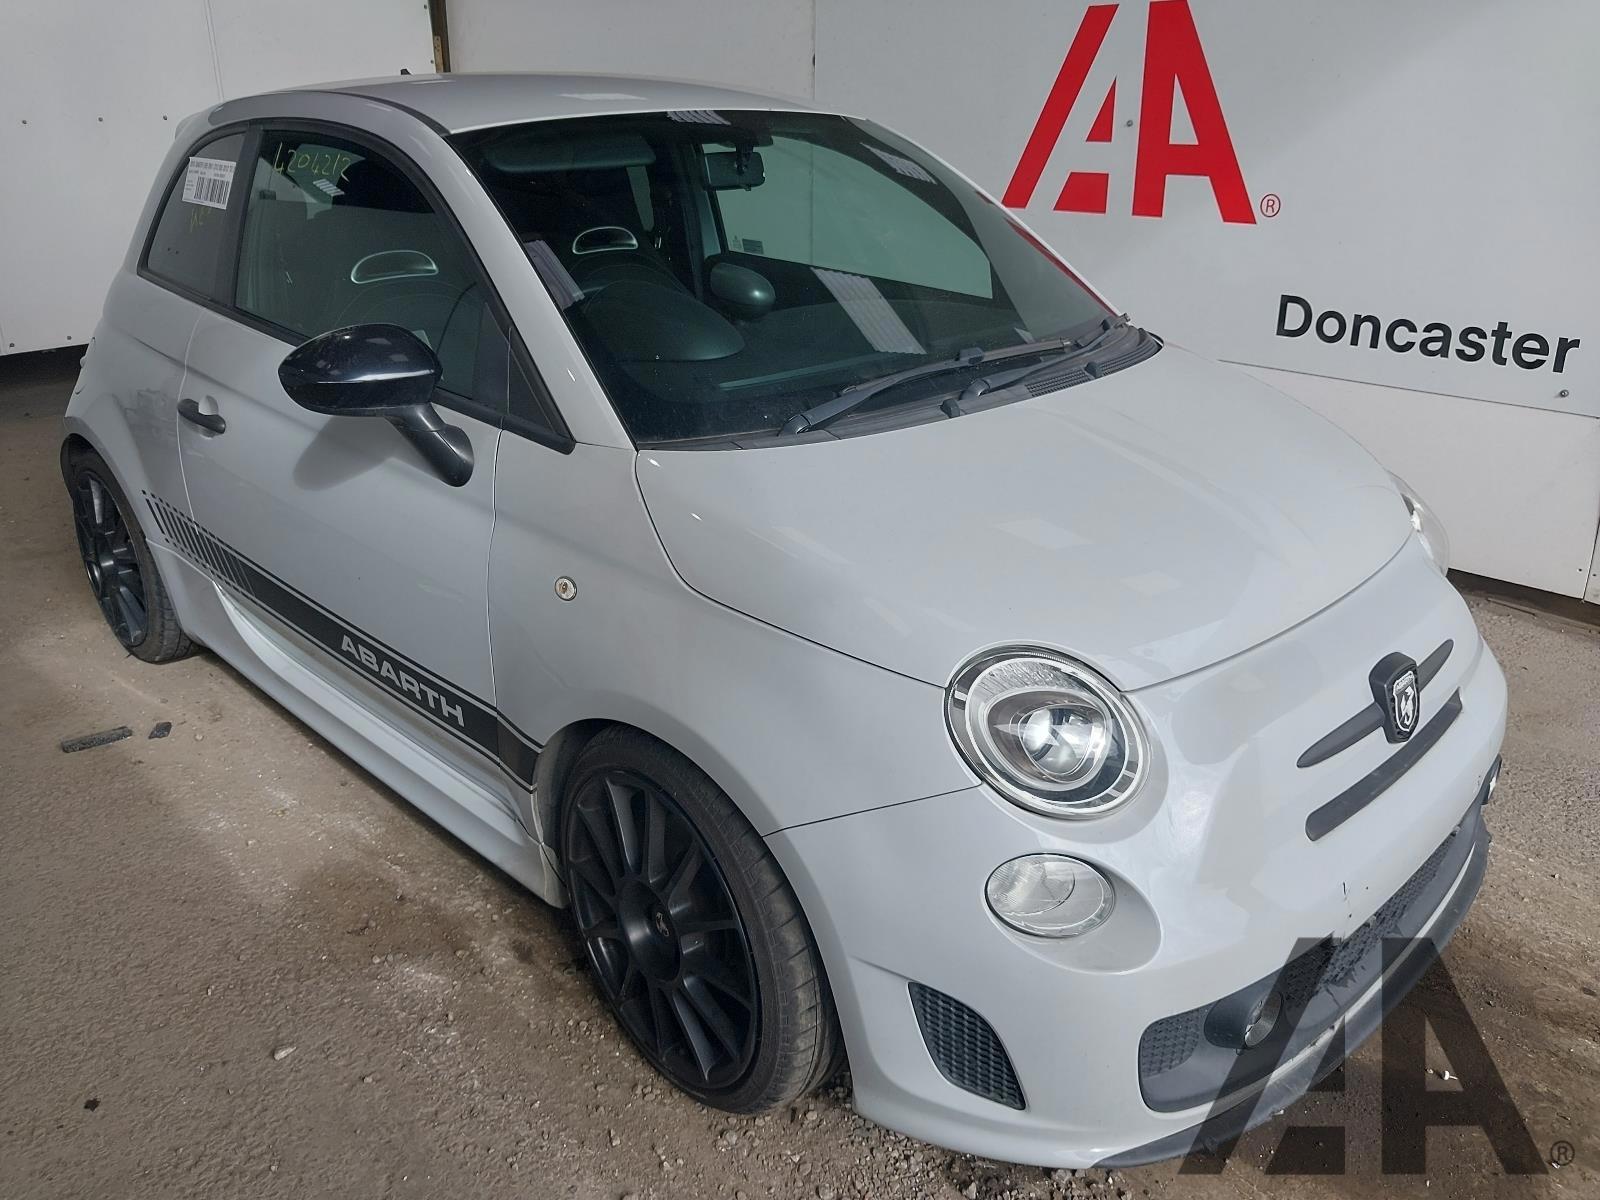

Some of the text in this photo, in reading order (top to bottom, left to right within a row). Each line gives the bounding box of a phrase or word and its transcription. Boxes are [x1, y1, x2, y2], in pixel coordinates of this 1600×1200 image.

[272, 141, 349, 182] 4204212
[1276, 294, 1581, 374] Doncaster
[341, 634, 465, 727] ABARTH
